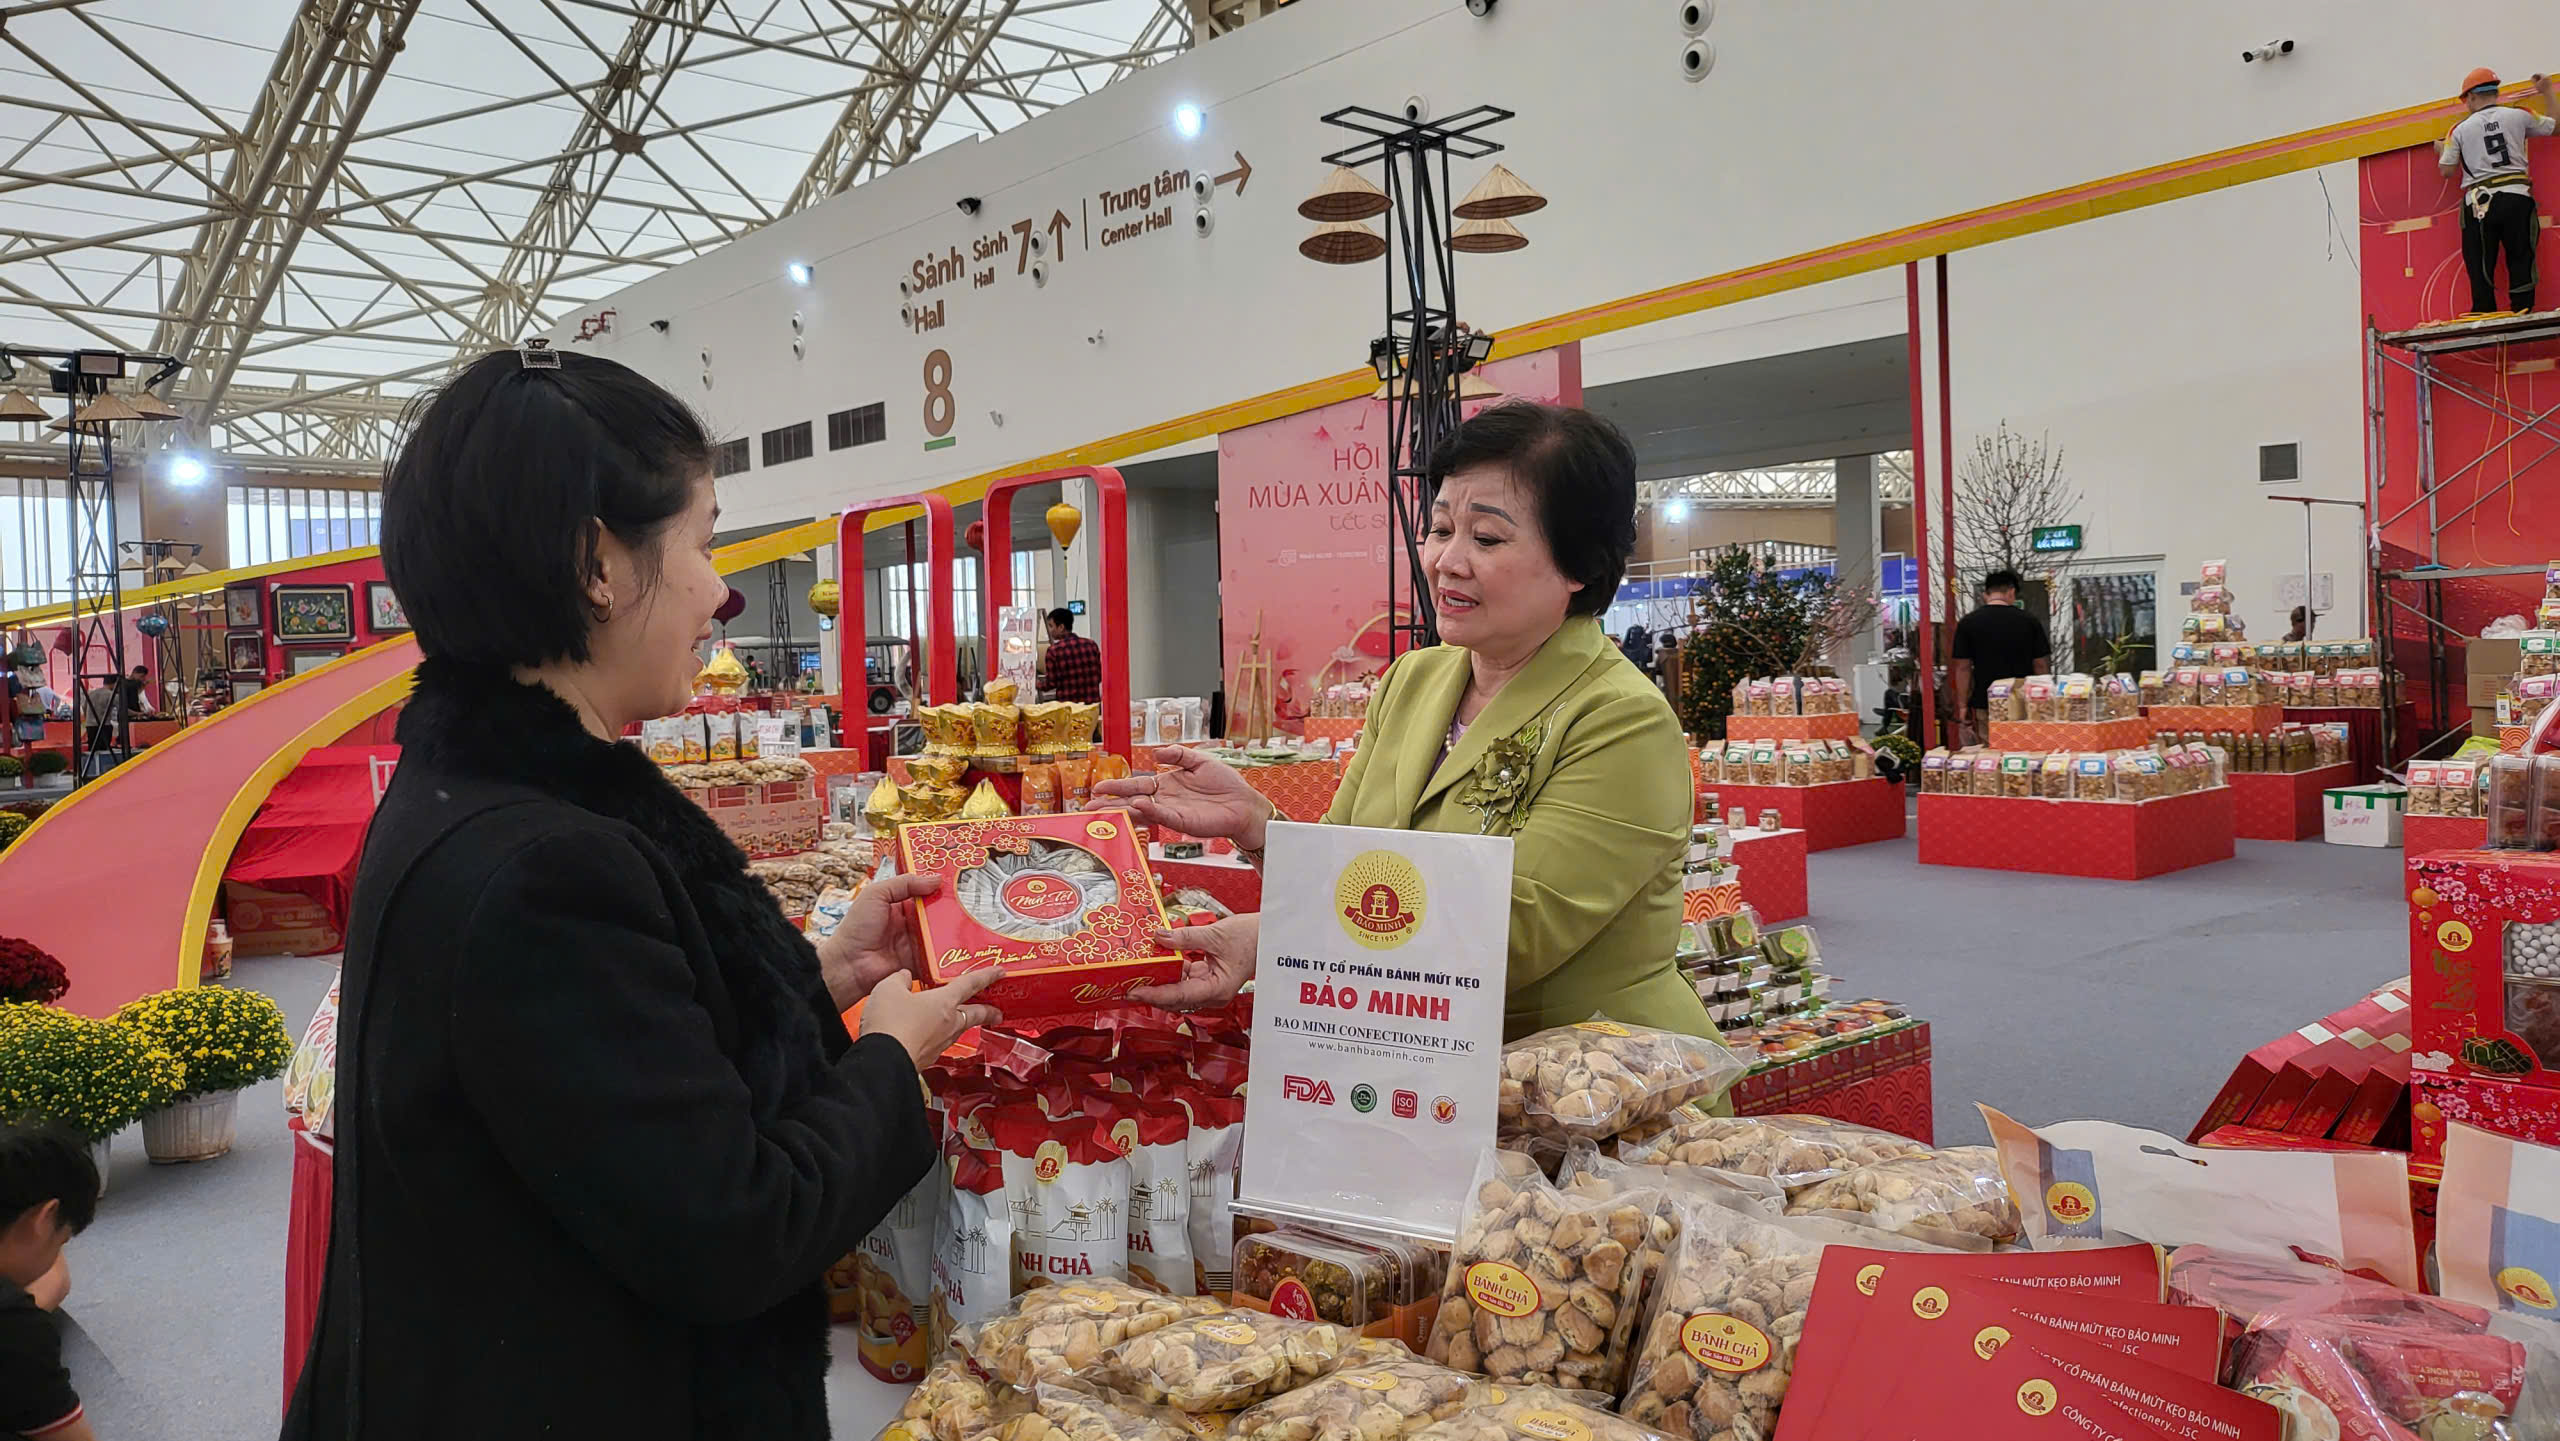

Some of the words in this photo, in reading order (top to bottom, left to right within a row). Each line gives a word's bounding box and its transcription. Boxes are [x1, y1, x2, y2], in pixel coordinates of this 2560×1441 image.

[2484, 132, 2511, 168] 9
[1099, 183, 1151, 217] Trung
[1154, 167, 1191, 198] tâm
[1101, 222, 1142, 247] Center
[1145, 205, 1172, 232] Hall
[973, 230, 1008, 262] Sảnh
[1011, 218, 1032, 275] 7
[912, 246, 965, 294] Sảnh
[973, 267, 995, 290] Hall
[914, 299, 945, 334] Hall
[923, 349, 956, 437] 8
[1333, 443, 1380, 475] HỘI
[1249, 481, 1310, 509] MÙA
[1318, 475, 1389, 506] XUÂN
[1358, 930, 1379, 942] SINCE
[1381, 934, 1399, 942] 1955
[1375, 919, 1402, 931] MINH
[1277, 956, 1309, 971] CÔNG
[1312, 961, 1326, 972] TY
[1329, 960, 1347, 975] CỔ
[1386, 967, 1420, 982] BÁNH
[1424, 971, 1452, 986] MỨT
[1455, 976, 1480, 990] KẸO
[1300, 975, 1358, 1010] BẢO
[1367, 990, 1451, 1021] MINH
[1274, 1016, 1300, 1030] BAO
[1302, 1020, 1336, 1035] MINH
[1451, 1040, 1475, 1053] JSC
[1308, 1041, 1435, 1065] www.banhbaominh.com
[1283, 1074, 1336, 1106] FDA
[1397, 1096, 1414, 1108] ISO
[870, 1235, 895, 1261] CHẢ
[1128, 1230, 1155, 1253] HẢ
[1018, 1251, 1043, 1273] NH
[1048, 1252, 1094, 1276] CHẢ
[1473, 1275, 1503, 1295] BÁNH
[1505, 1288, 1529, 1306] CHẢ
[2022, 1276, 2046, 1289] MỨT
[2048, 1278, 2068, 1291] KẸO
[2070, 1275, 2092, 1287] BẢO
[2093, 1275, 2121, 1287] MINH
[1691, 1329, 1730, 1351] BÁNH
[1732, 1341, 1759, 1358] CHẢ
[2049, 1317, 2078, 1331] BÁNH
[2080, 1321, 2104, 1335] MỨT
[2105, 1326, 2126, 1341] KẸO
[2127, 1327, 2150, 1342] BẢO
[2152, 1333, 2180, 1346] MINH
[2121, 1342, 2140, 1356] JSC
[2064, 1359, 2080, 1377] CỔ
[2110, 1380, 2140, 1402] BÁNH
[2139, 1391, 2165, 1412] MỨT
[2165, 1402, 2187, 1421] KẸO
[2188, 1410, 2211, 1428] BẢO
[2211, 1419, 2241, 1440] MINH
[2062, 1404, 2093, 1432] CÔNG
[2093, 1424, 2107, 1440] TY
[2178, 1425, 2200, 1441] JSC
